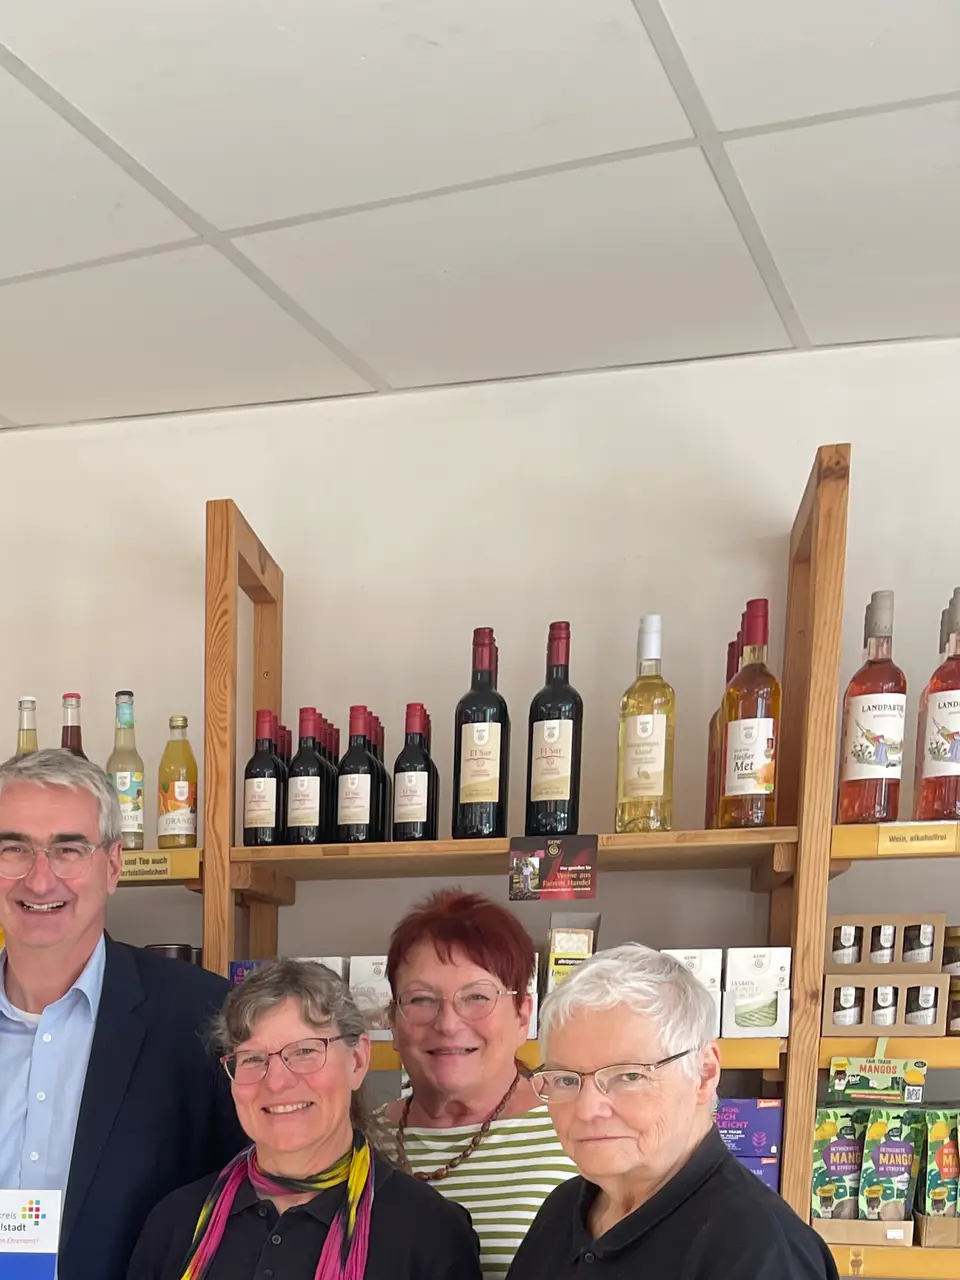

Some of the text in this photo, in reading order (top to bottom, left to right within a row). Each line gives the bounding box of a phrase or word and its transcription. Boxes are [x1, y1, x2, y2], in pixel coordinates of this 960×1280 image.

[733, 761, 754, 772] Met
[859, 1064, 897, 1074] MANGOS
[879, 1153, 912, 1166] MANGO
